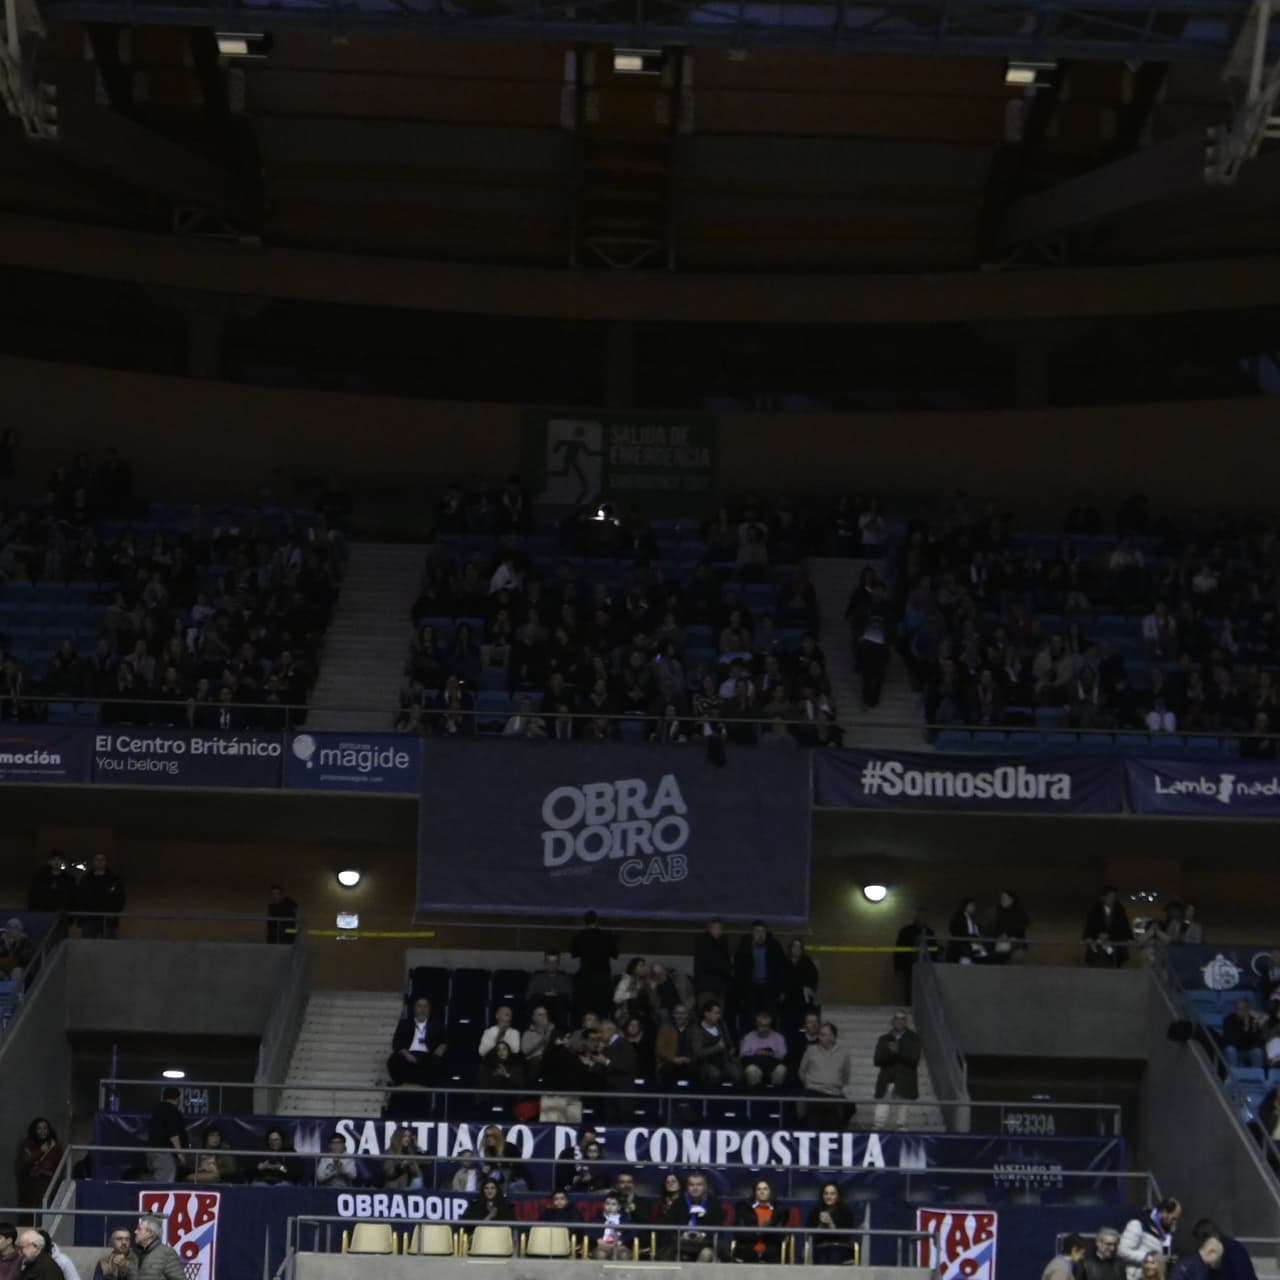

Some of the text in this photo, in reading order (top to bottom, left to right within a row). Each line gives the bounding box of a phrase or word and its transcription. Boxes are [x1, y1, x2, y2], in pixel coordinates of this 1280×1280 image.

[95, 735, 282, 757] El Centro Británico
[320, 745, 410, 773] magide
[95, 757, 179, 775] You belong
[861, 761, 1072, 800] #SomosObra
[541, 773, 688, 830] OBRA
[540, 814, 690, 868] DOIRO
[618, 853, 689, 887] CAB
[555, 1125, 606, 1161] D
[337, 1193, 468, 1221] OBRADOIR
